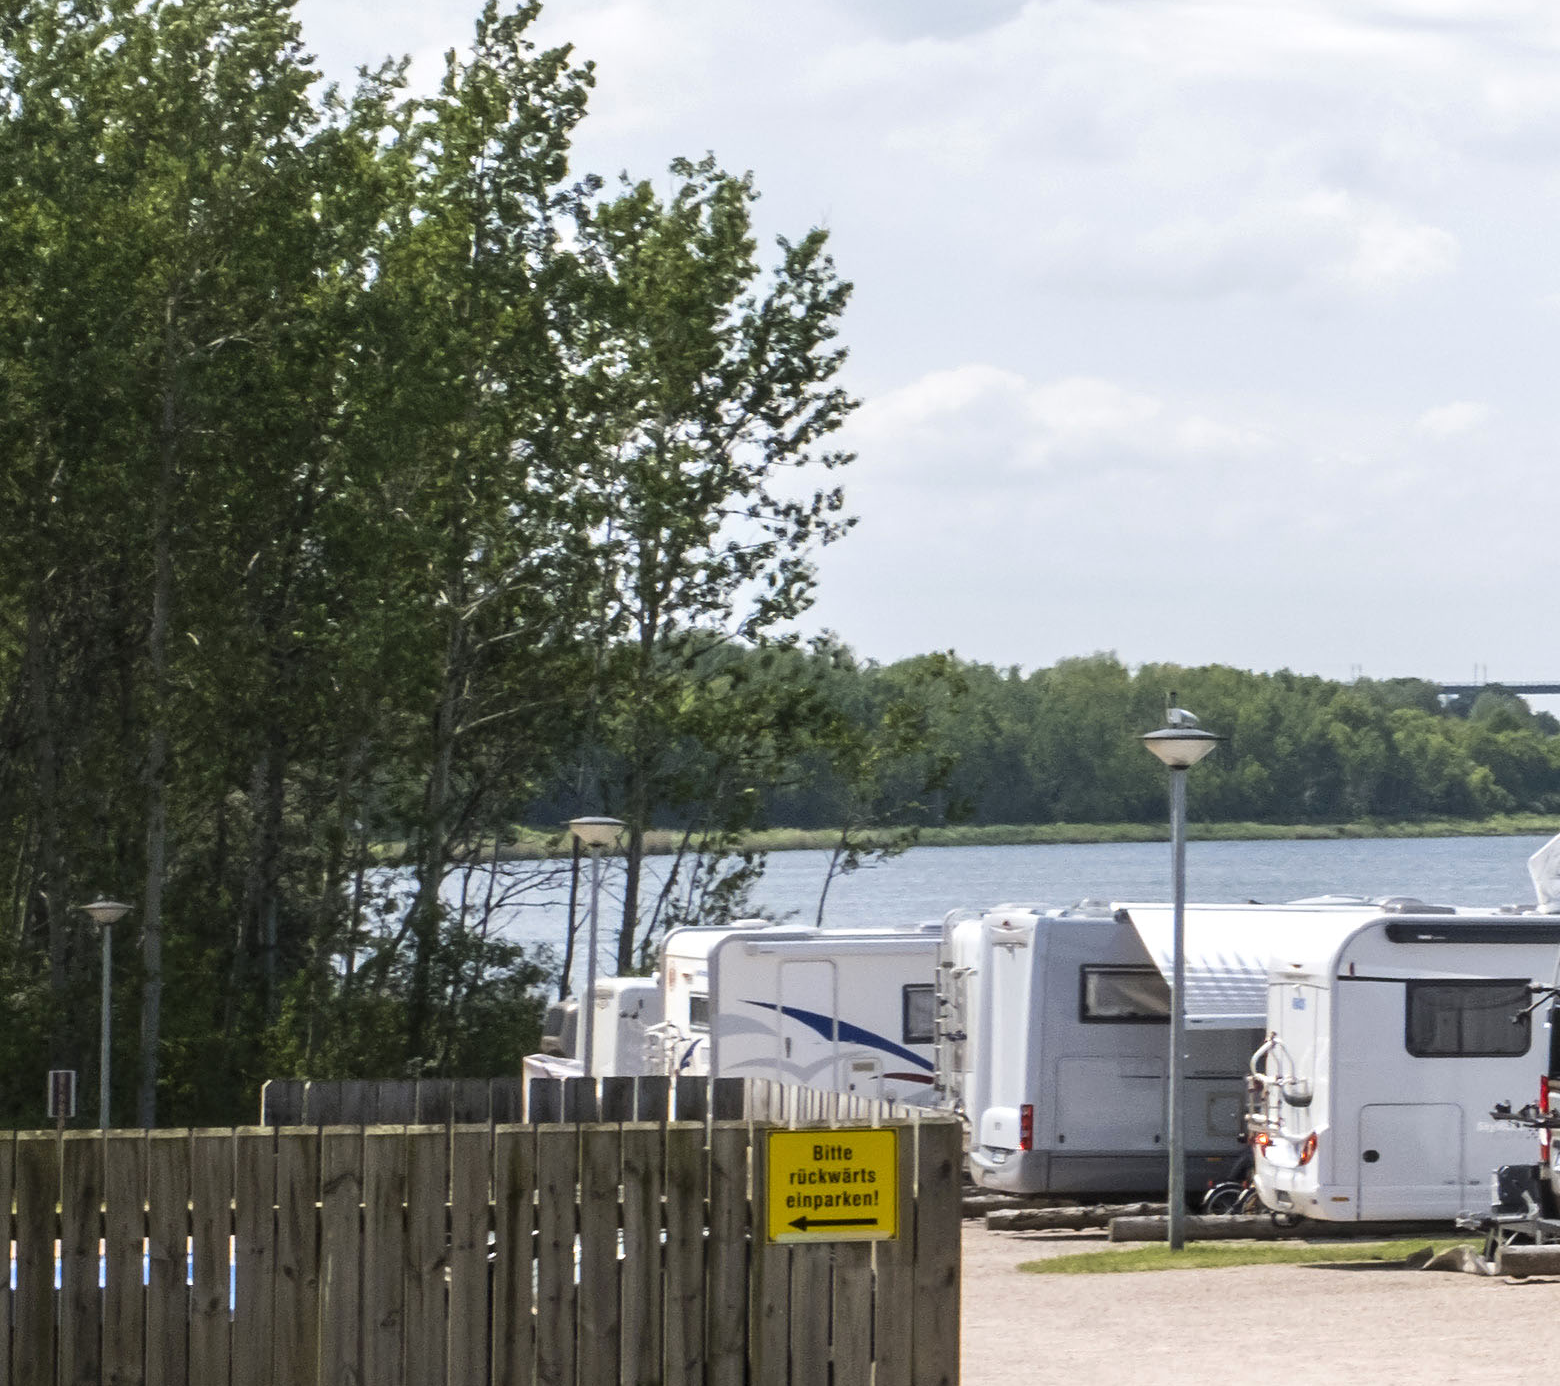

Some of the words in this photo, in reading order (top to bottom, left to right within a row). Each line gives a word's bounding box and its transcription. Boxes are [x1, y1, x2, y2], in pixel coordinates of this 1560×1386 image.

[813, 1145, 853, 1161] Bitte
[789, 1168, 877, 1185] rückwärts
[786, 1190, 879, 1211] einparken!
